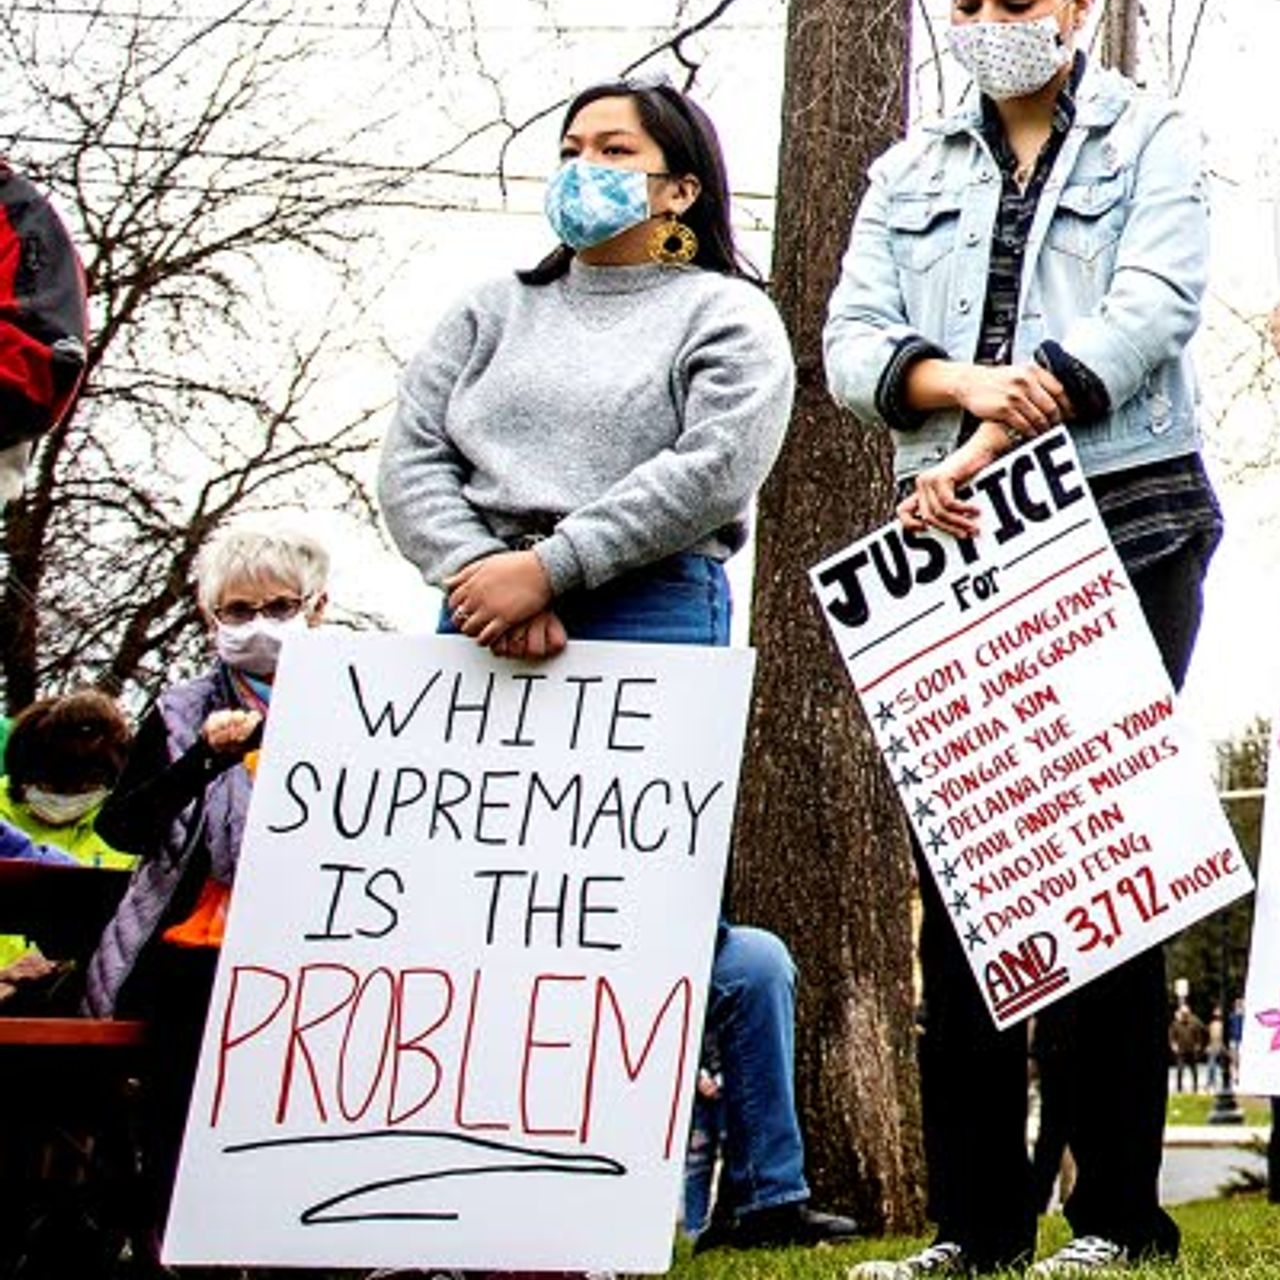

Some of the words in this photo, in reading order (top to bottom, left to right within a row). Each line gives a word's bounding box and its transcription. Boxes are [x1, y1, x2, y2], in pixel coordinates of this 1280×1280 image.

[951, 567, 999, 612] For
[349, 665, 656, 750] WHITE
[907, 694, 970, 747] HYUN
[979, 656, 1039, 708] JUNG
[1037, 608, 1117, 667] GRANT
[921, 717, 1009, 778] SUNCHA
[1012, 684, 1060, 723] KIM
[932, 743, 1019, 810] YONGAE
[1025, 715, 1074, 753] YUE
[948, 775, 1041, 840] DELAINA
[1041, 730, 1112, 788] ASHLEY
[1113, 695, 1173, 740] YAUN
[267, 761, 723, 855] SUPREMACY
[961, 830, 1014, 871] PAUL
[1015, 784, 1086, 839] ANDRE
[1088, 735, 1179, 795] MICHELS
[971, 833, 1067, 899] XIAOJIE
[1070, 802, 1124, 846] TAN
[1080, 832, 1152, 881] FENG
[305, 863, 404, 939] IS
[475, 870, 625, 950] THE
[985, 931, 1058, 1008] AND
[1065, 866, 1169, 951] 3,792
[1169, 848, 1241, 902] more
[211, 964, 690, 1160] PROBLEM
